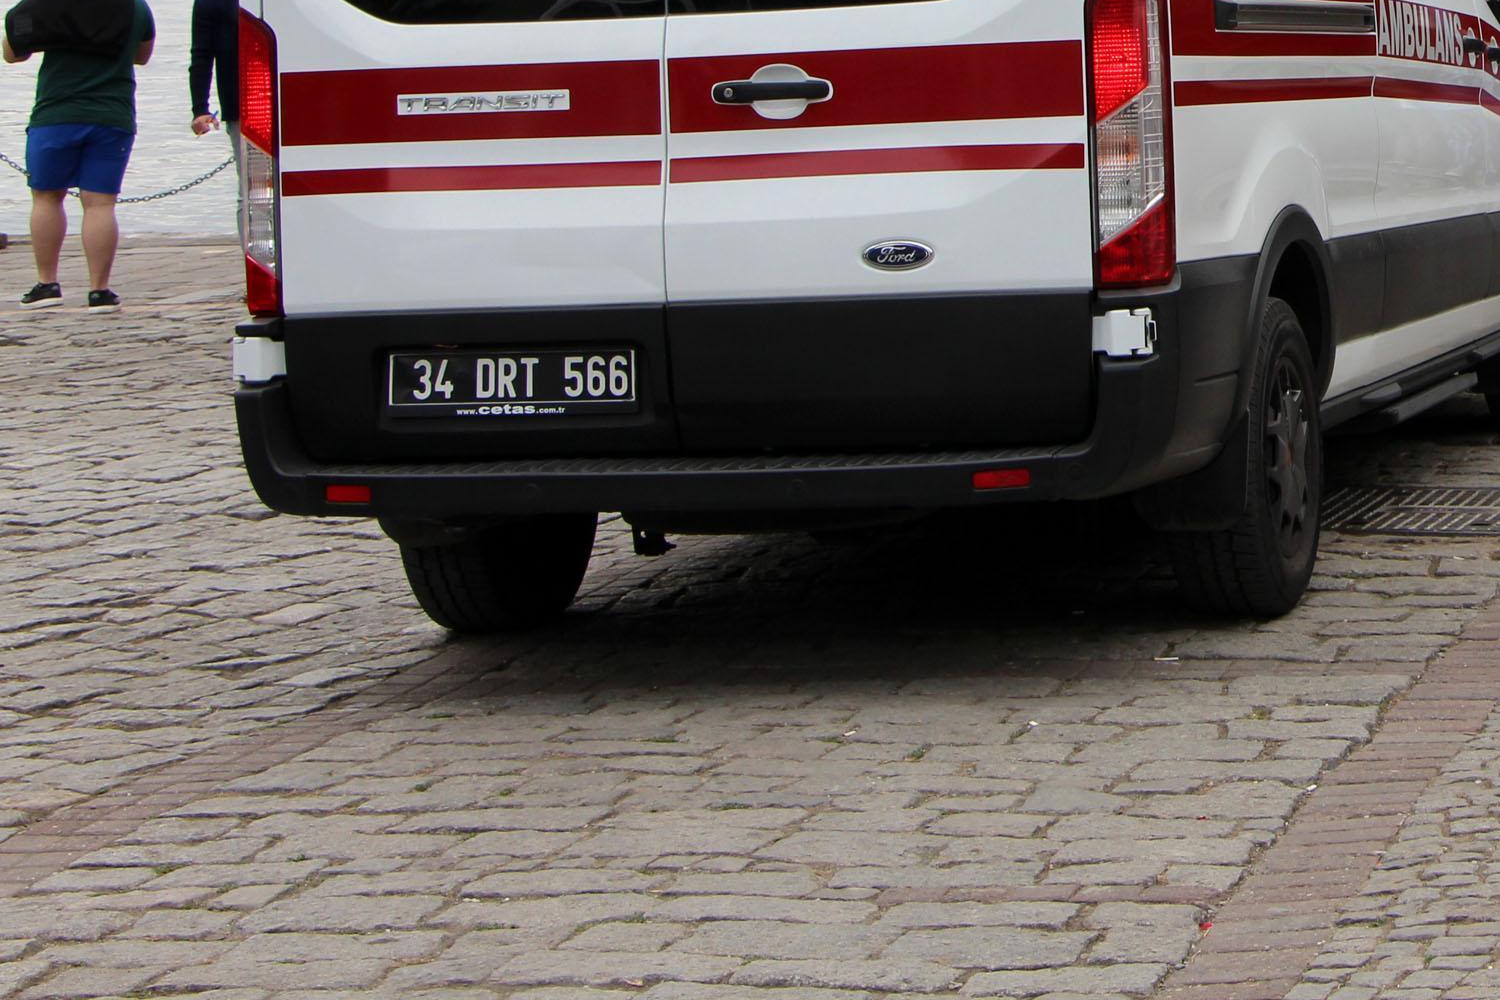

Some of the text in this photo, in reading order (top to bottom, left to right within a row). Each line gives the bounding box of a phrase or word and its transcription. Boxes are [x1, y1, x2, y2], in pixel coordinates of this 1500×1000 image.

[400, 93, 567, 113] TRANSIT
[876, 245, 916, 263] Ford
[412, 355, 629, 400] 34 DRT 566
[456, 403, 566, 416] www.cetas.com.tr
